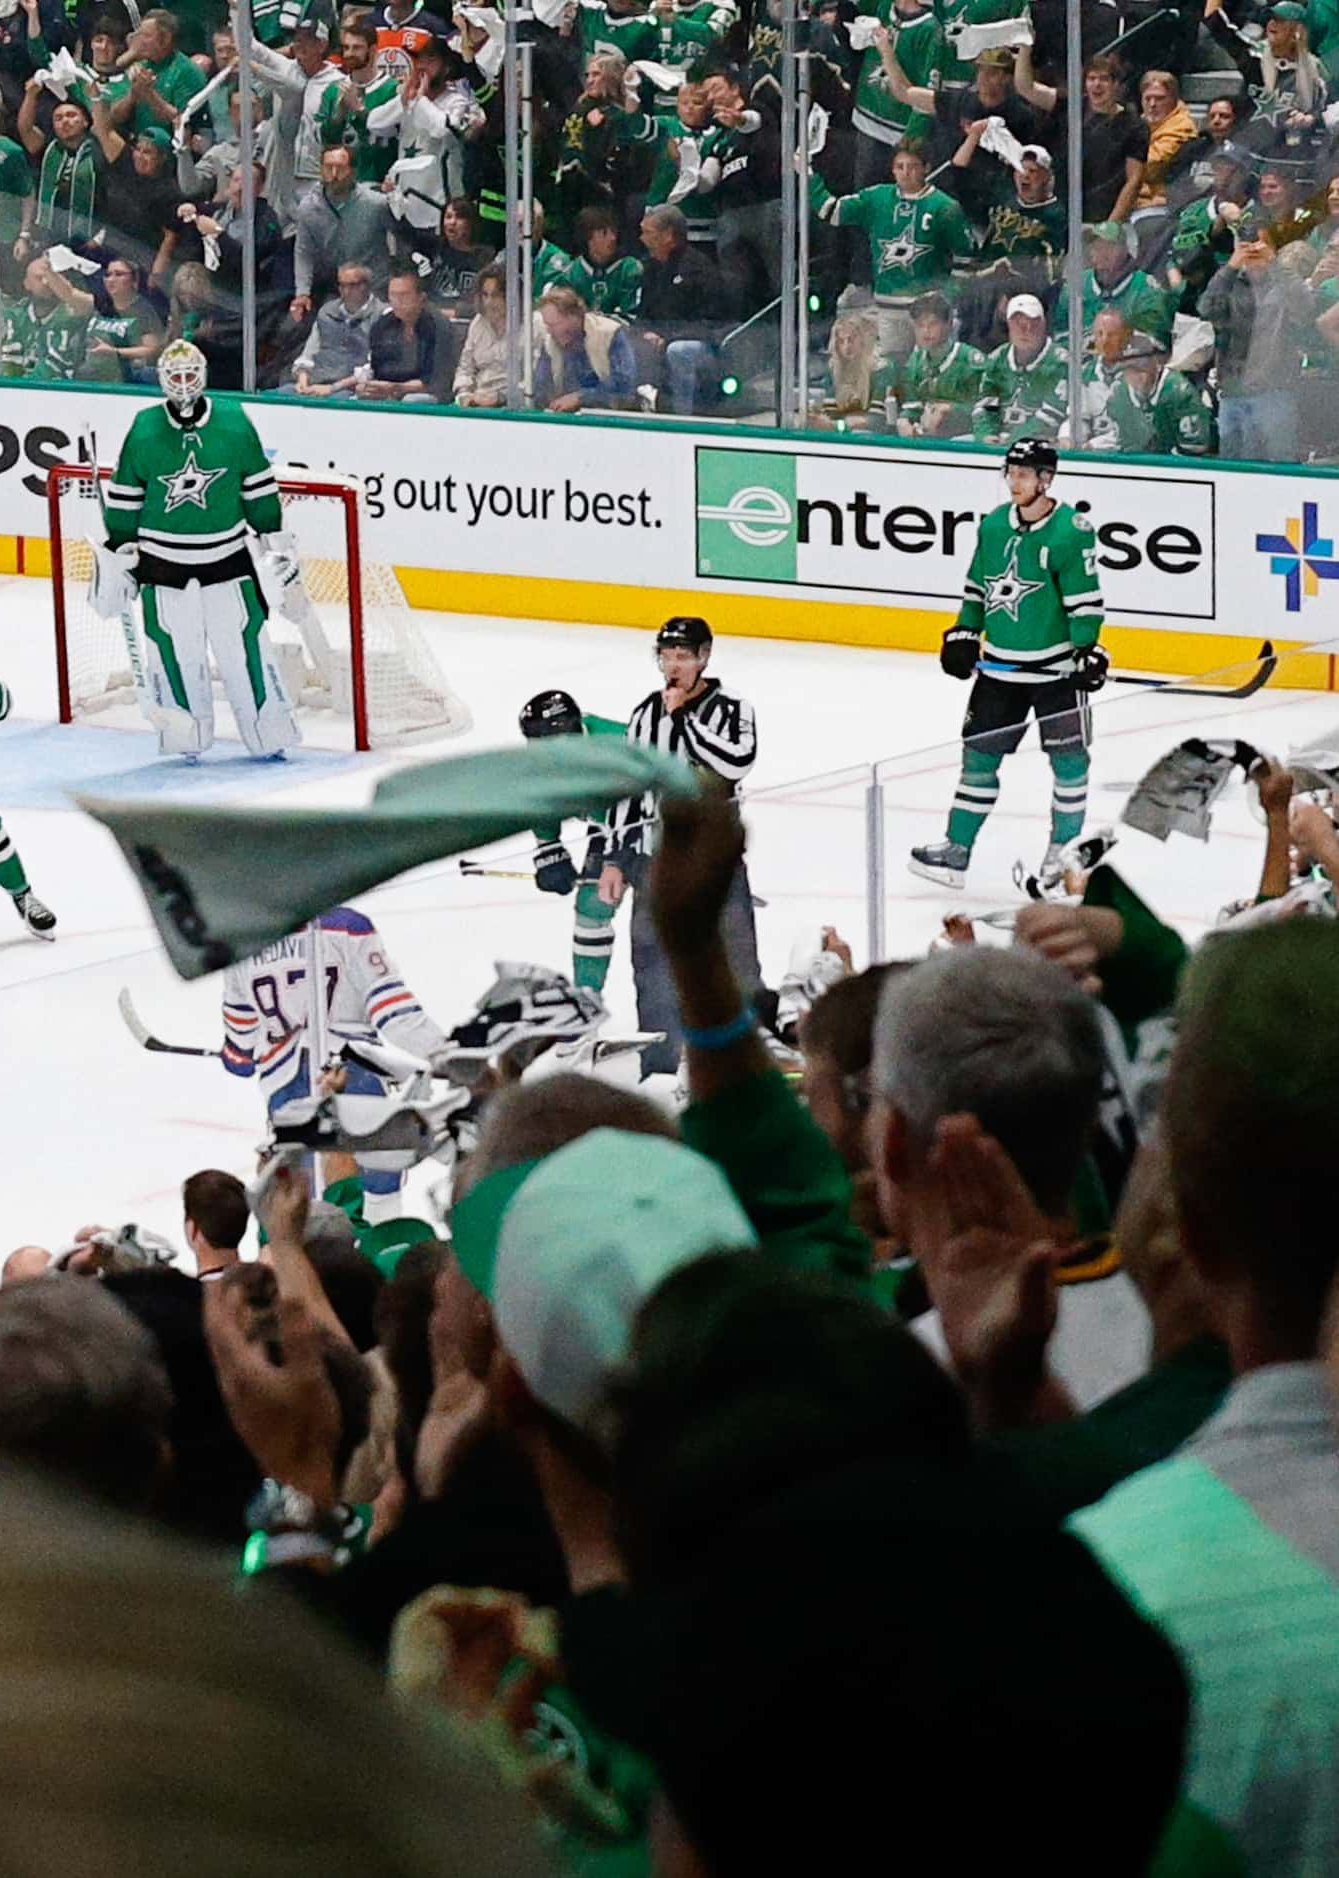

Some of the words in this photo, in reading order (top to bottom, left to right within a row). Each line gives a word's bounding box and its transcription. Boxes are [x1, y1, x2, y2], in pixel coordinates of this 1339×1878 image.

[393, 474, 457, 514] out
[466, 481, 555, 526] your
[565, 479, 662, 528] best.
[715, 485, 1202, 574] enterse
[252, 965, 339, 1045] 97
